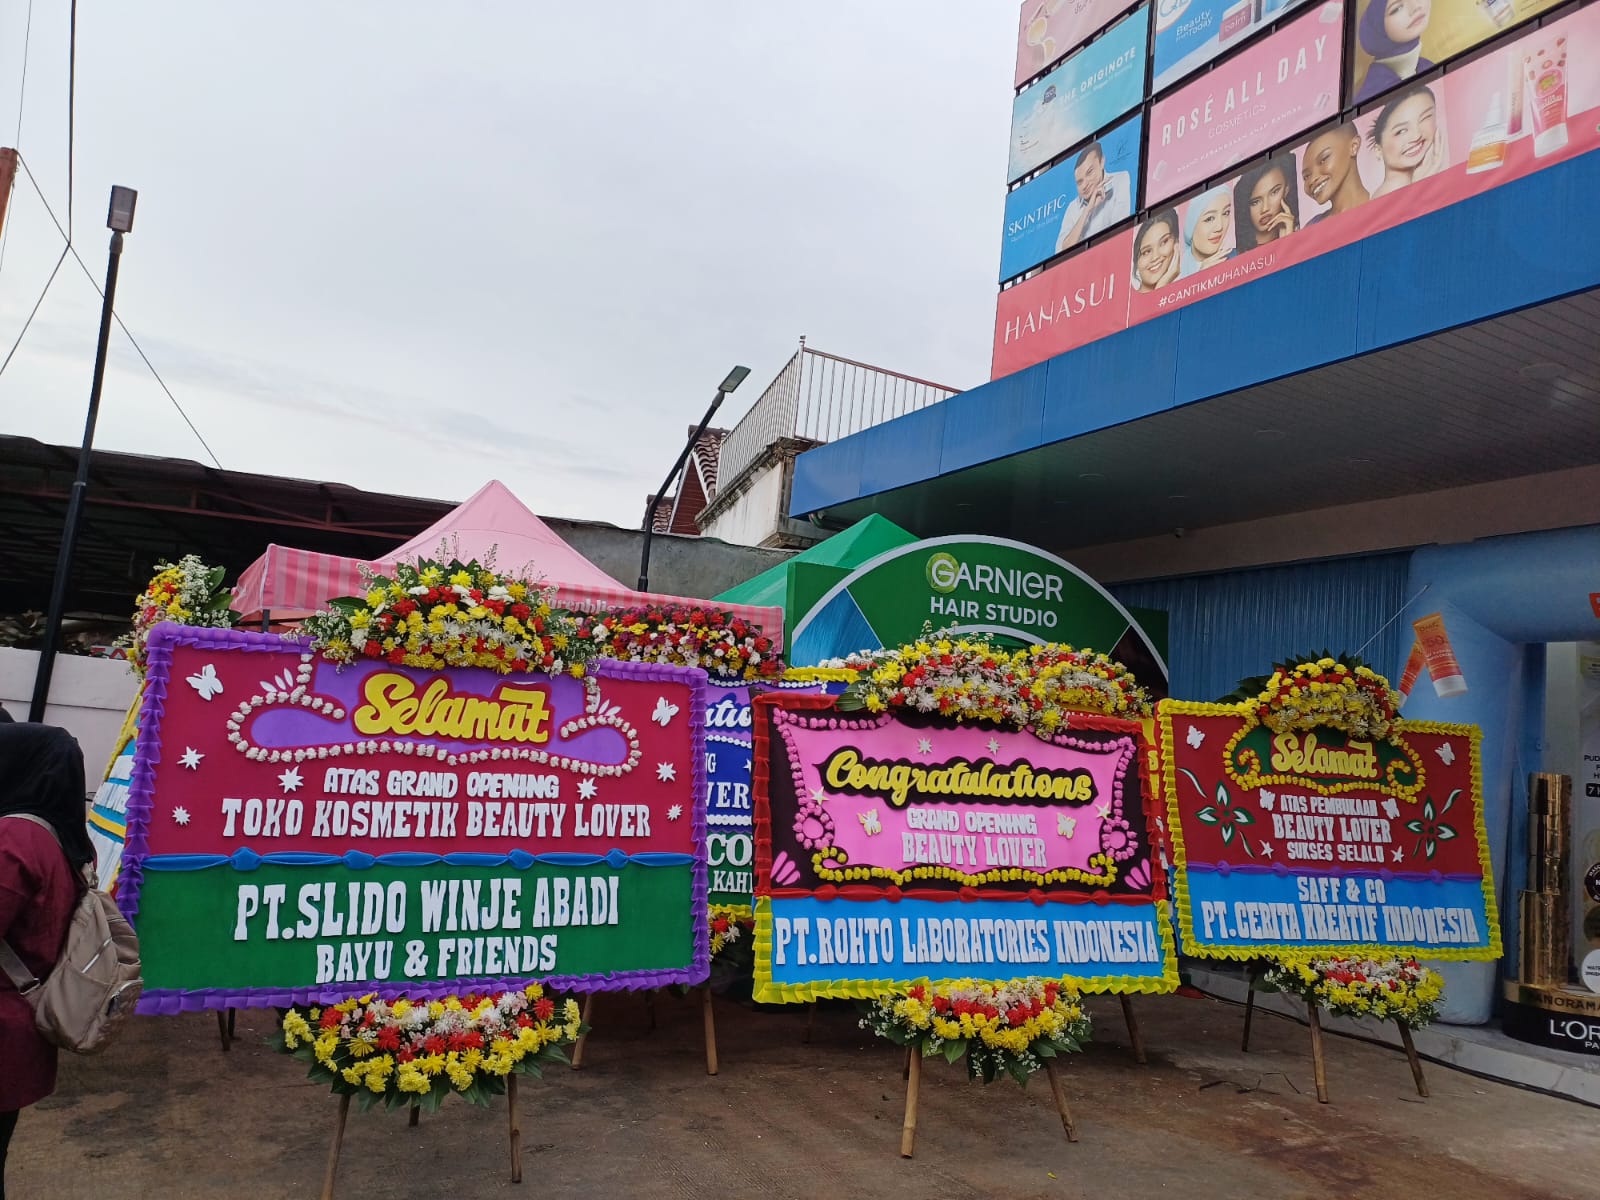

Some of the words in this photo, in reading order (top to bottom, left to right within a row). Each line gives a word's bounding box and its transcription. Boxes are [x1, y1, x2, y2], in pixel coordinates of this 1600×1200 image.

[1080, 47, 1137, 92] ORIGINOTE
[1162, 96, 1214, 147] ROSÉ
[1224, 71, 1264, 113] ALL
[1277, 34, 1327, 84] DAY
[1007, 193, 1067, 237] SKINTIFIC
[1158, 253, 1276, 308] #CANTIKMUHANASUI
[1003, 273, 1116, 344] HANASUI
[924, 552, 1064, 603] GARNIER
[930, 596, 979, 620] HAIR
[985, 602, 1058, 628] STUDIO
[353, 672, 552, 742] Selamat
[1271, 733, 1377, 777] Selamat
[324, 767, 379, 795] ATAS
[386, 770, 457, 798] GRAND
[466, 773, 559, 799] OPENING
[826, 750, 1092, 806] Congratulations
[222, 798, 303, 837] TOKO
[312, 801, 457, 838] KOSMETIK
[466, 802, 568, 838] BEAUTY
[574, 804, 651, 838] LOVER
[906, 808, 960, 831] GRAND
[965, 811, 1037, 835] OPENING
[1273, 813, 1334, 840] BEAUTY
[1341, 817, 1392, 843] LOVER
[902, 833, 977, 866] BEAUTY
[983, 837, 1047, 867] LOVER
[1287, 841, 1333, 861] SUKSES
[1338, 843, 1384, 862] SELALU
[234, 881, 407, 940] PT.SLIDO
[420, 877, 523, 932] WINJE
[533, 877, 619, 927] ABADI
[1297, 877, 1339, 902] SAFF
[1345, 878, 1361, 902] &
[1364, 878, 1385, 903] CO
[775, 918, 893, 966] PT.ROHTO
[902, 919, 1050, 964] LABORATORIES
[1054, 919, 1159, 964] INDONESIA
[1202, 902, 1301, 939] PT.CERITA
[1303, 904, 1378, 941] KREATIF
[1383, 906, 1479, 943] INDONESIA
[315, 940, 394, 984] BAYU
[404, 940, 429, 976] &
[438, 935, 558, 976] FRIENDS
